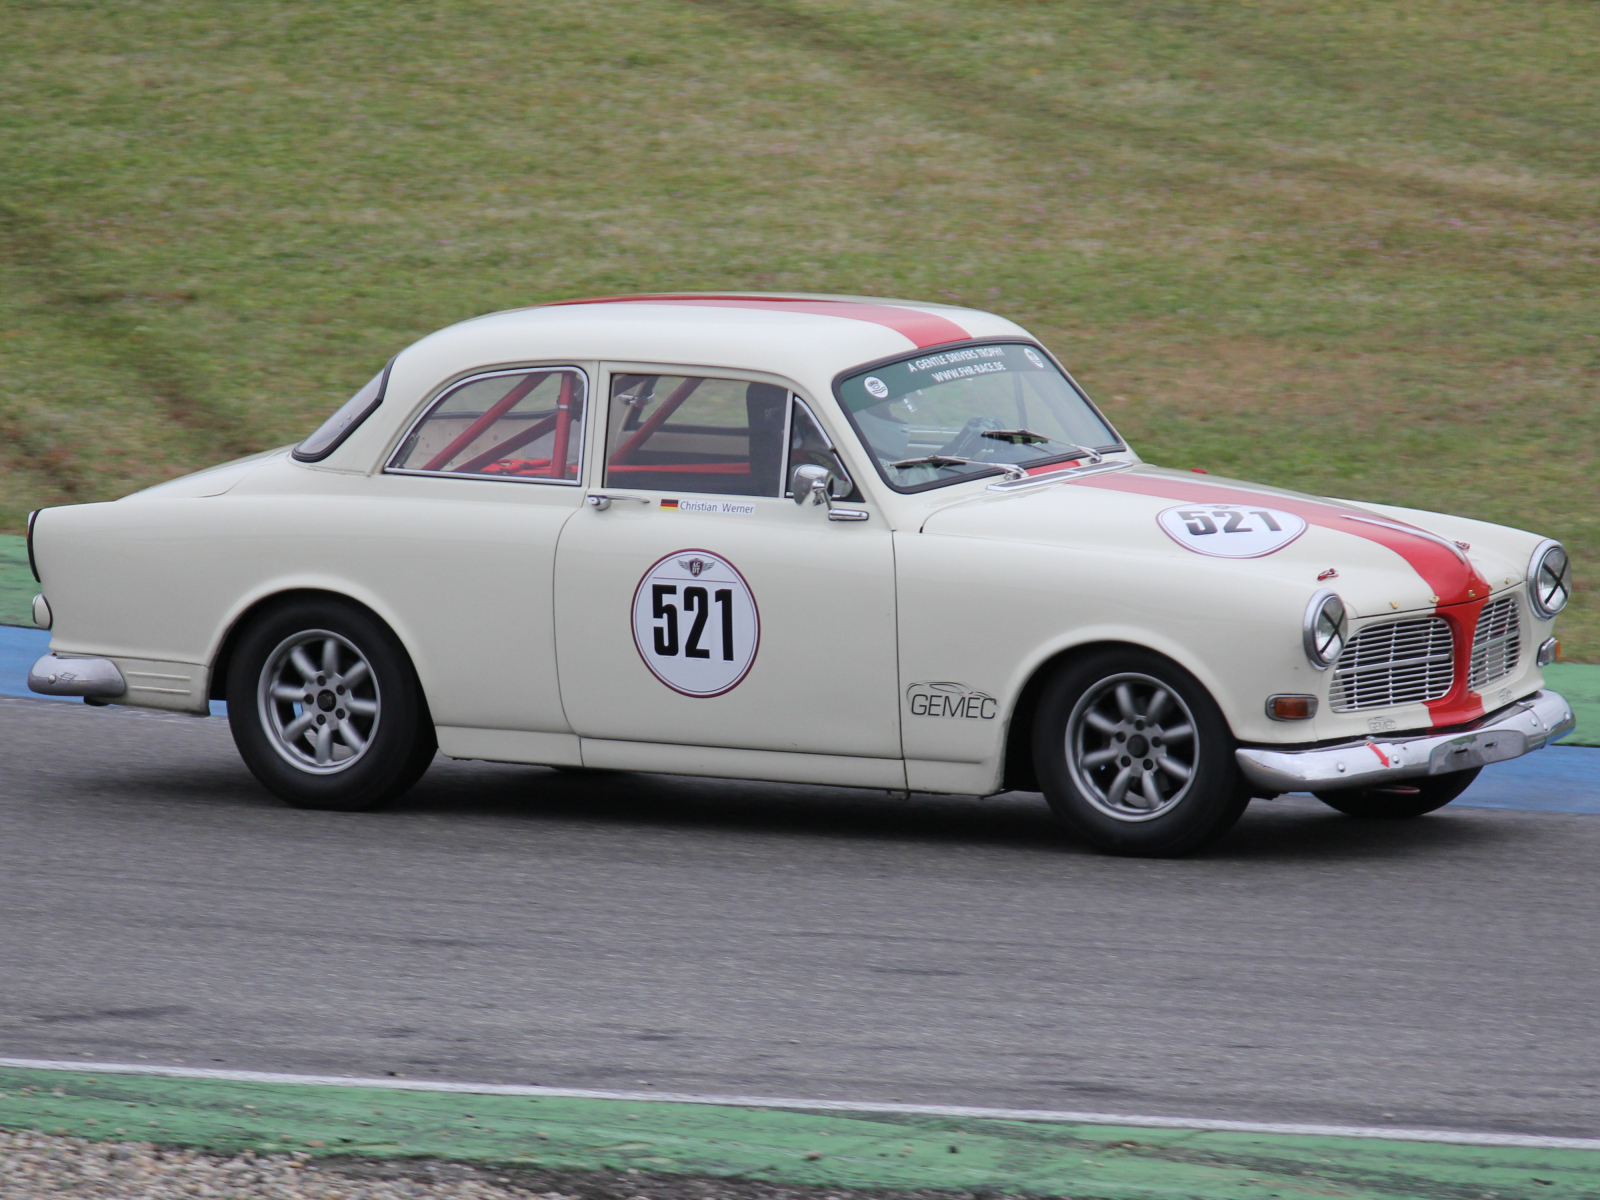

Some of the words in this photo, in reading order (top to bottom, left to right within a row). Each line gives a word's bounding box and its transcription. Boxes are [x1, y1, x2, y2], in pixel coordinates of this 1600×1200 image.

[907, 362, 918, 373] A
[915, 354, 948, 370] GENTLE
[945, 349, 979, 363] DRIVERS
[975, 346, 1005, 358] TROPHY
[931, 361, 1007, 382] WWW.FHR-RACE.DE
[680, 500, 718, 512] Christian
[722, 502, 755, 514] Werner
[1177, 511, 1283, 536] 521
[652, 583, 735, 662] 521
[911, 693, 997, 720] GEMEC
